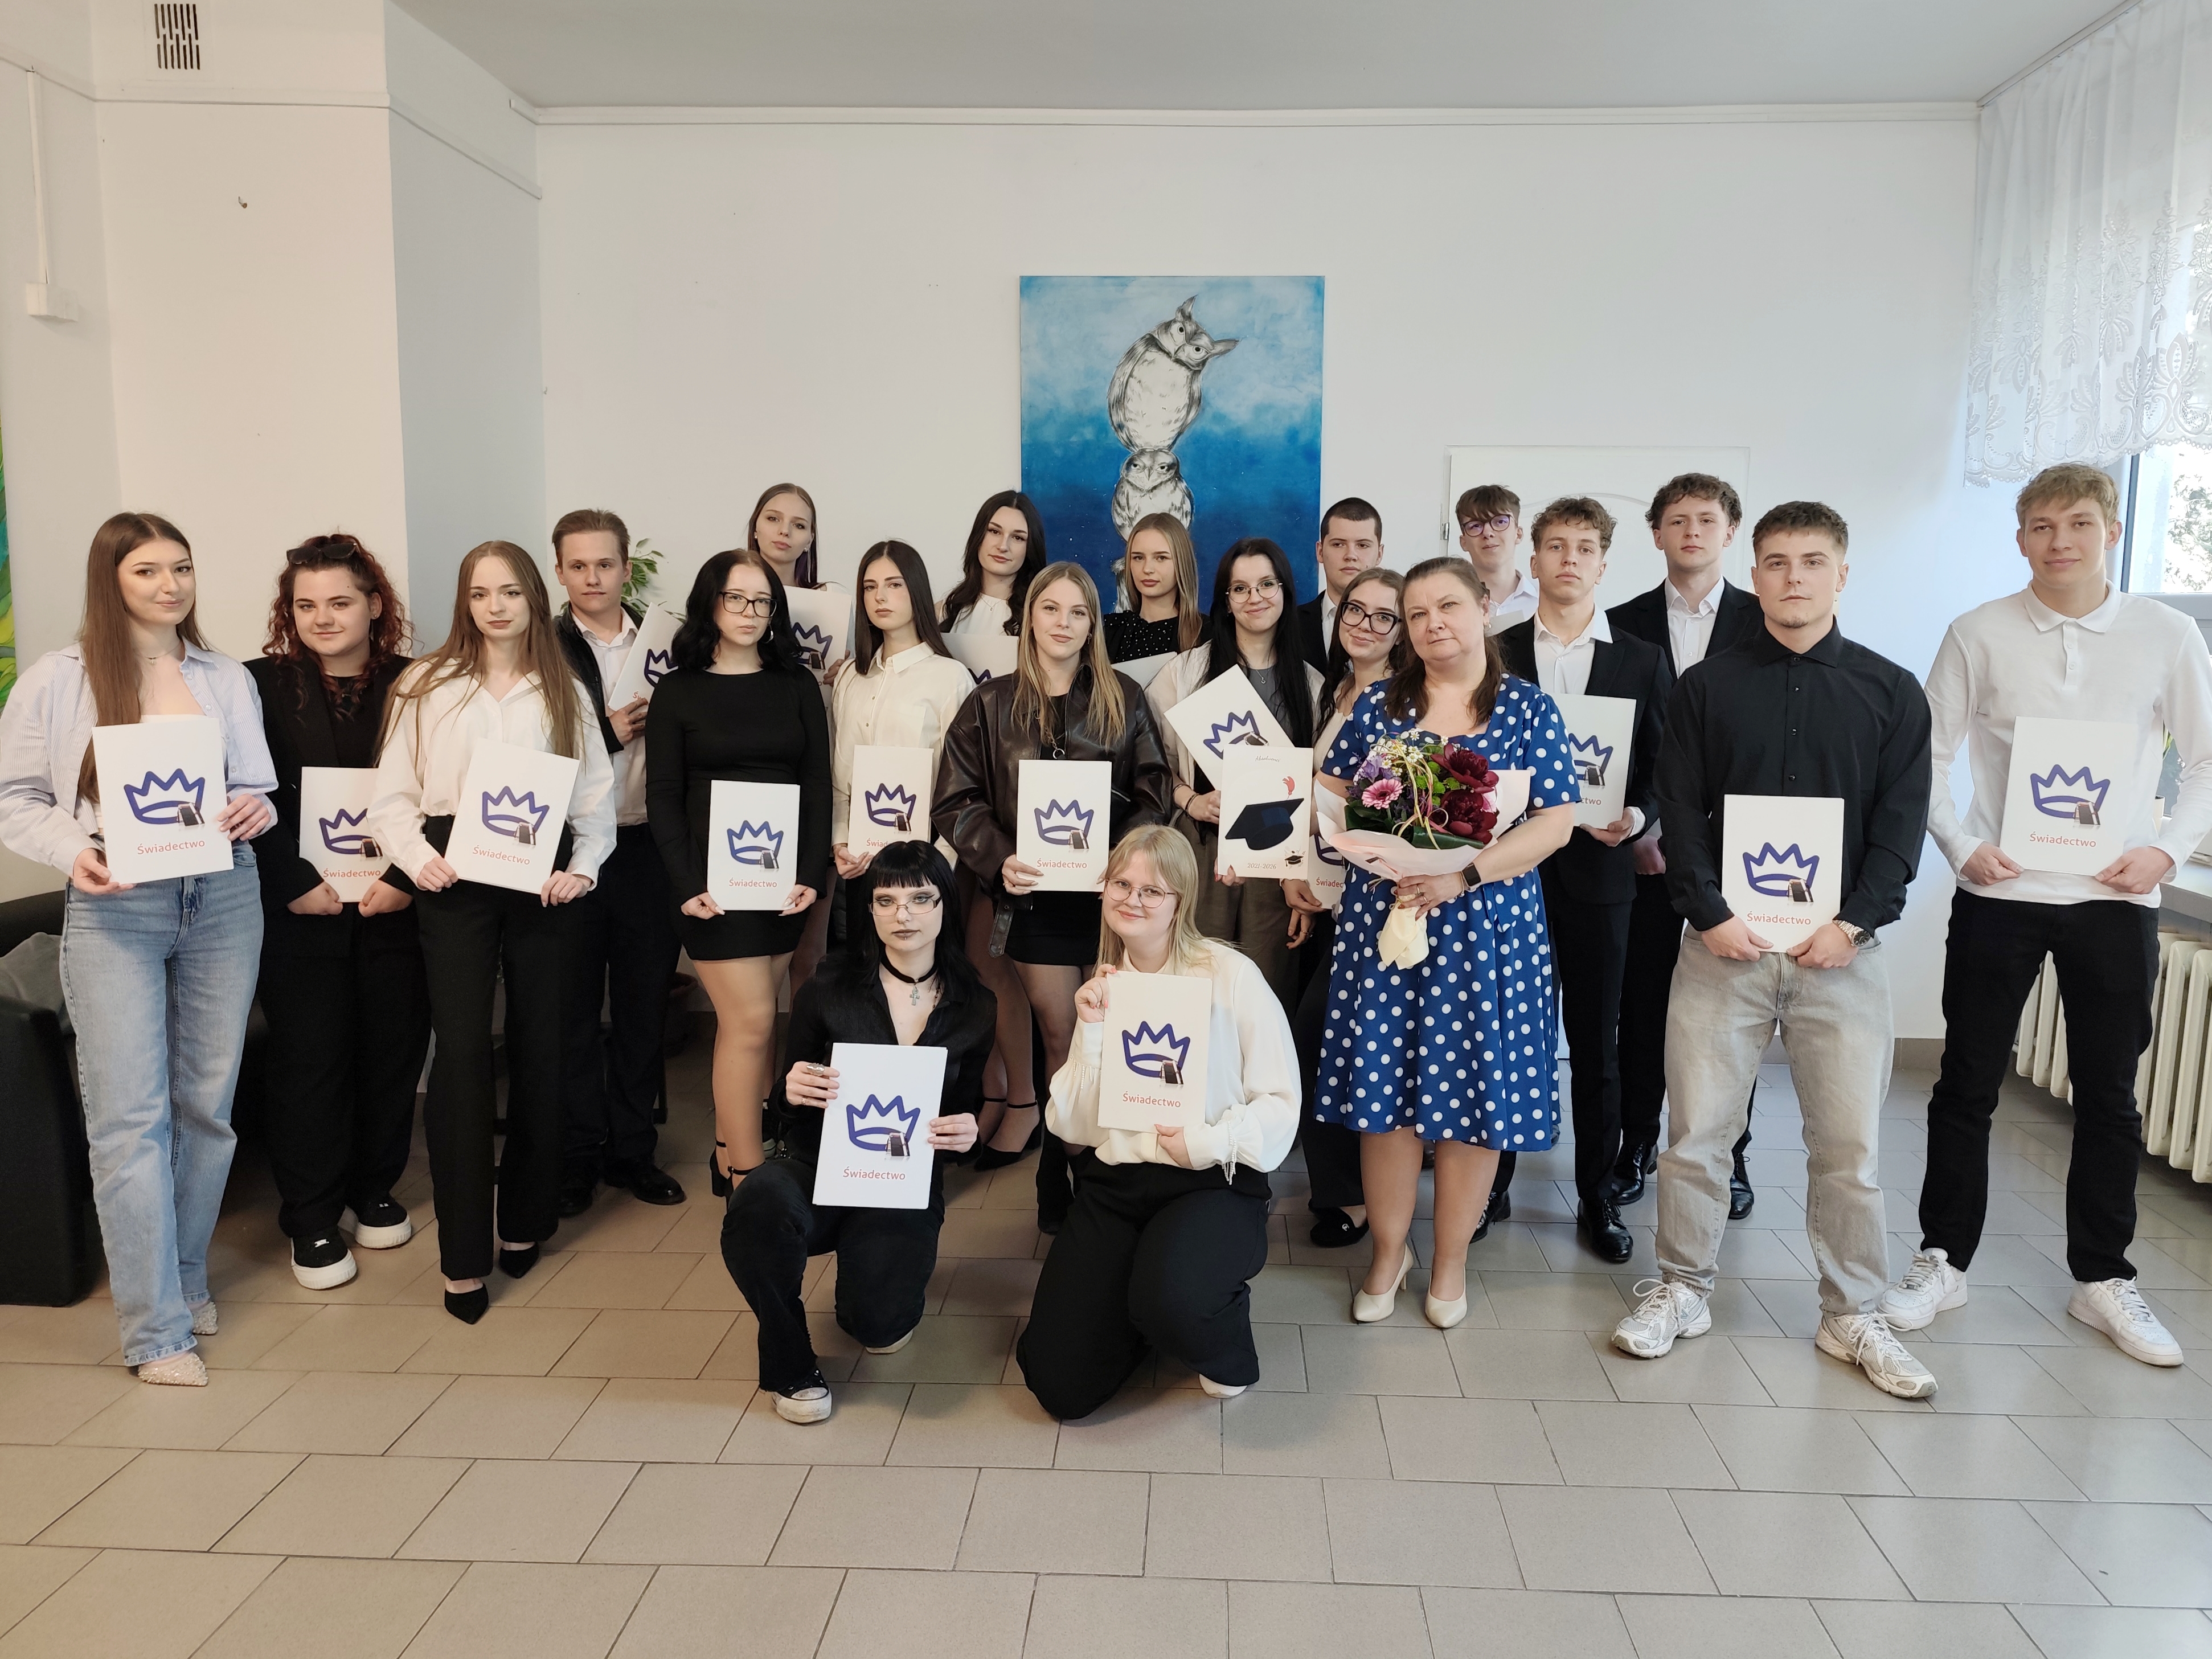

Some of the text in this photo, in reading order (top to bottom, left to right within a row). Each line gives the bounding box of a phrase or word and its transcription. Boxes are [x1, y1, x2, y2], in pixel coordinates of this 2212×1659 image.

[2029, 831, 2096, 847] Świadectwo
[137, 840, 205, 855] Świadectwo
[472, 845, 530, 865] Świadectwo
[1037, 858, 1087, 869] Świadectwo
[323, 867, 381, 878] Świadectwo
[729, 877, 777, 888] Świadectwo
[1747, 911, 1812, 925] Świadectwo
[1122, 1091, 1181, 1108] Świadectwo
[843, 1166, 906, 1180] Świadectwo
